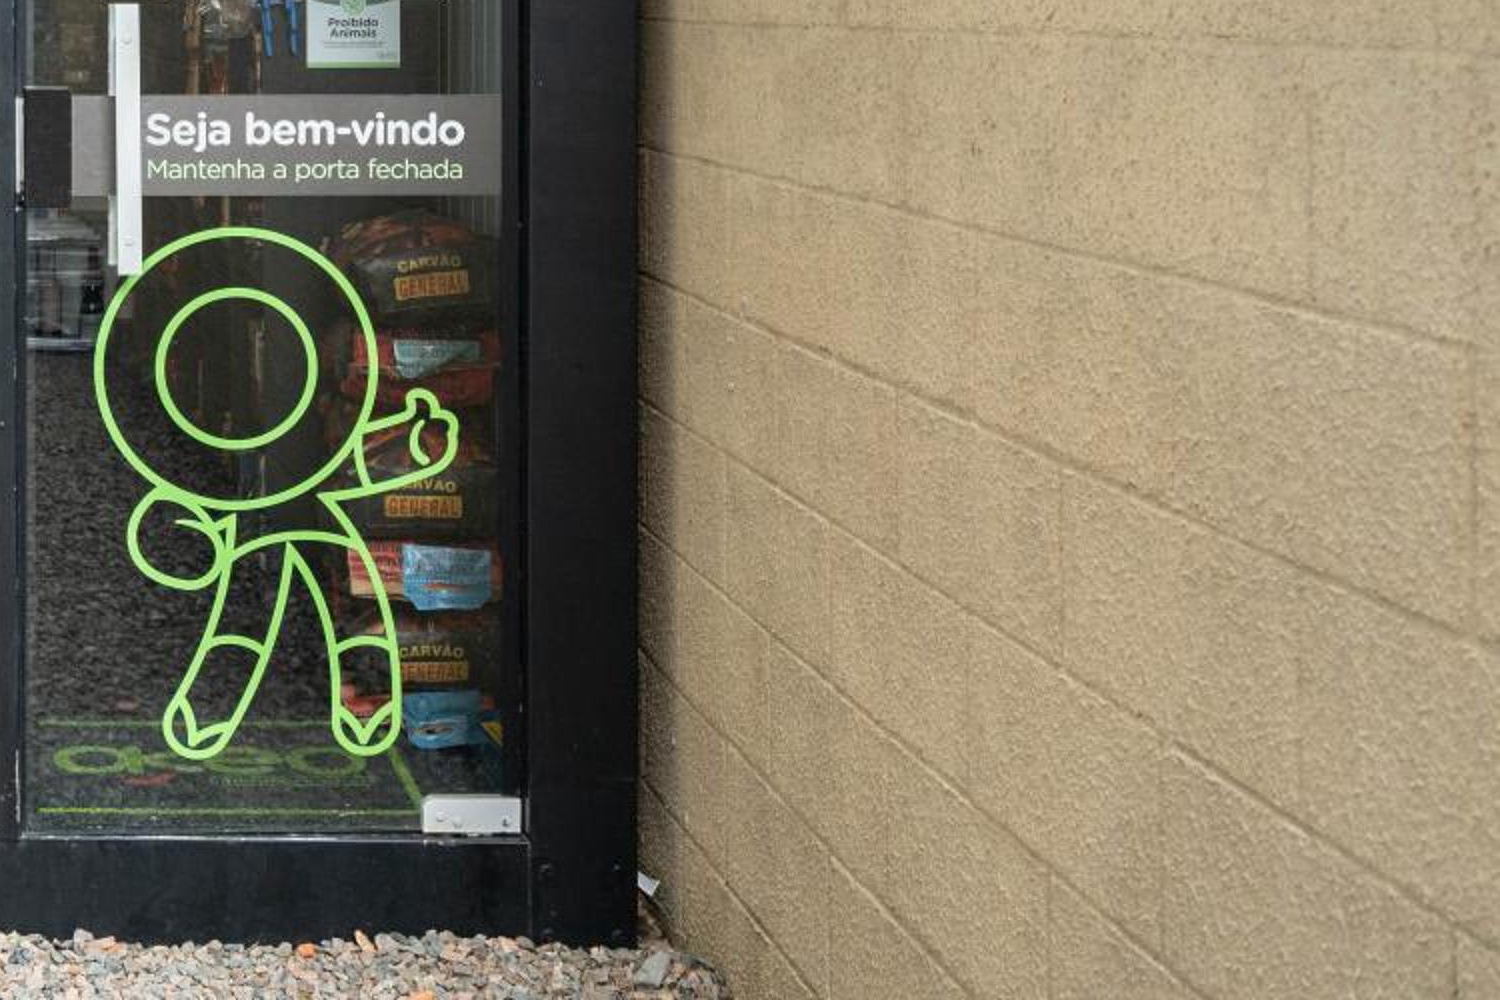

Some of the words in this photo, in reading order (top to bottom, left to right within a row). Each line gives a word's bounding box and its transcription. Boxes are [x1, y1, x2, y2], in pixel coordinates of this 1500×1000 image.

[330, 27, 377, 38] Animais
[146, 113, 231, 151] Seja
[245, 113, 465, 147] bem-vindo
[147, 161, 265, 180] Mantenha
[273, 165, 290, 180] a
[295, 162, 360, 184] porta
[368, 158, 464, 180] fechada
